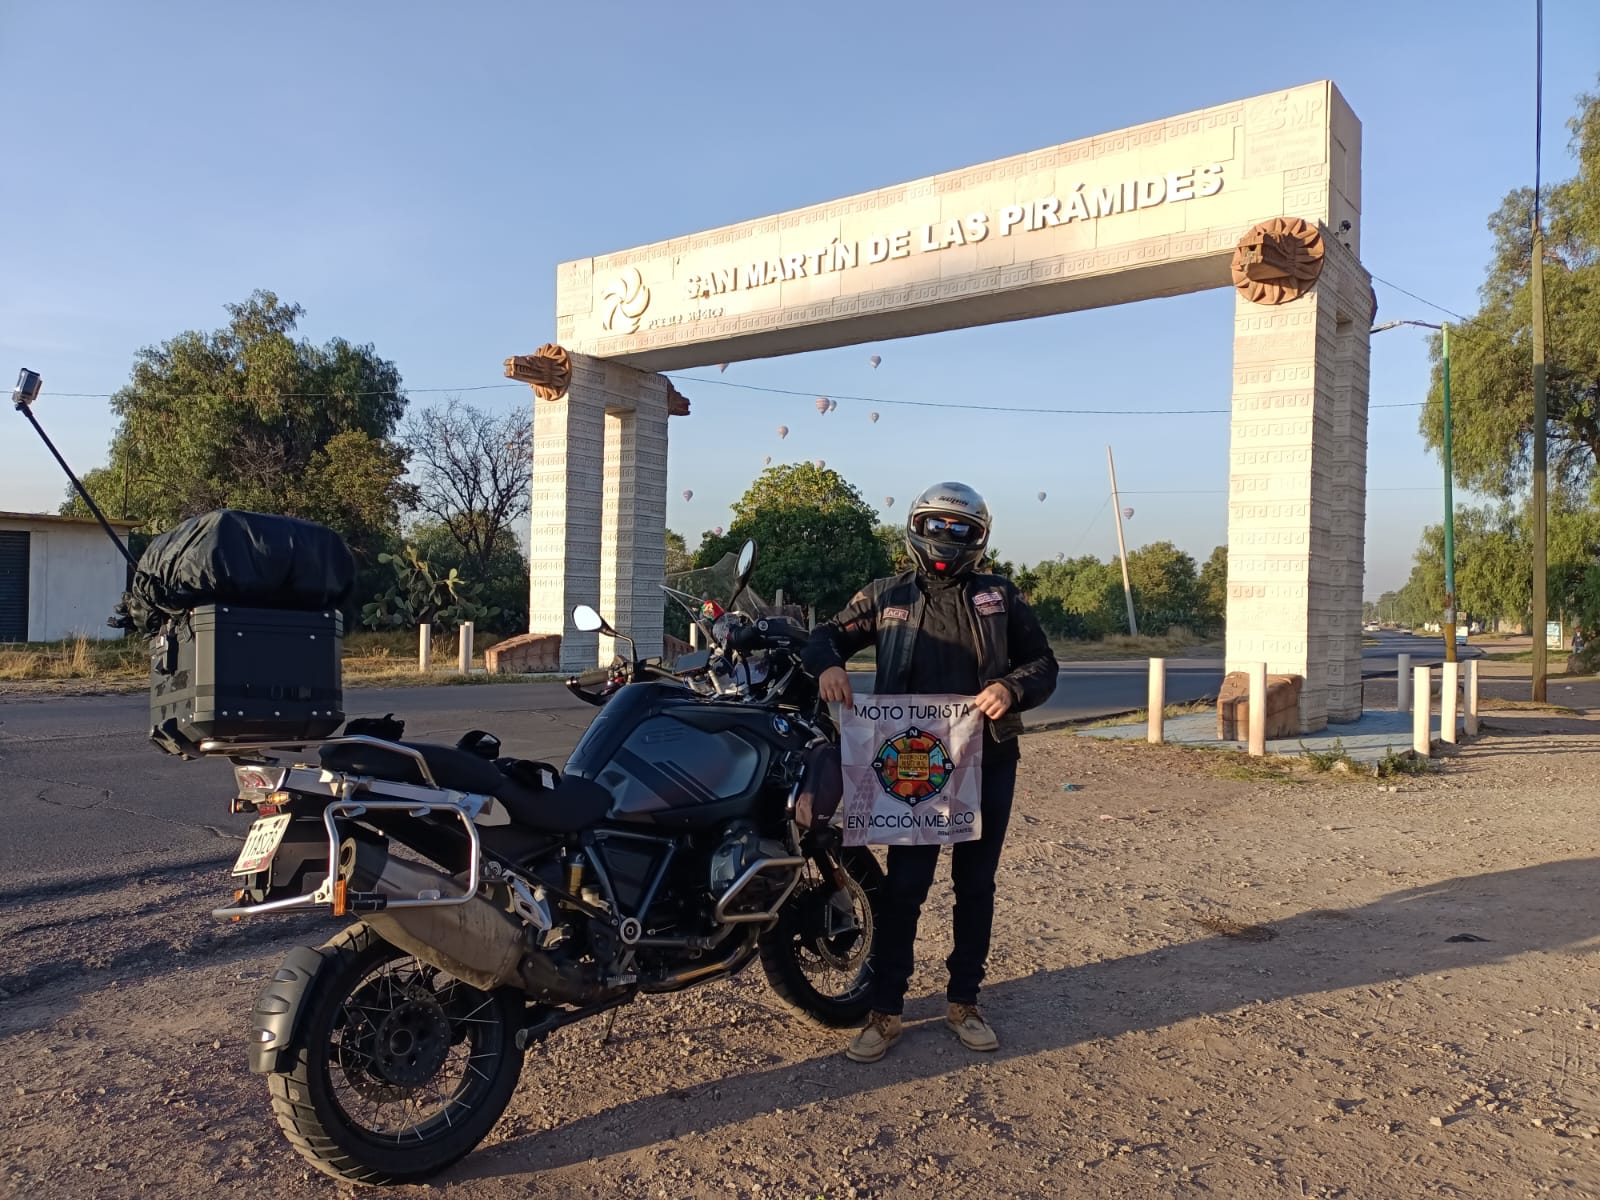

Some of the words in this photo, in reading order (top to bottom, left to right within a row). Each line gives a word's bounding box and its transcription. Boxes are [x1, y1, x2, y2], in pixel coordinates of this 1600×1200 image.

[687, 267, 737, 299] SAN
[745, 238, 859, 290] MARTÍN
[867, 230, 911, 264] DE
[920, 212, 989, 252] LAS
[999, 165, 1225, 237] PIRÁMIDES
[854, 704, 903, 720] MOTO
[908, 703, 970, 719] TURISTA
[847, 815, 865, 828] EN
[868, 812, 921, 828] ACCIÓN
[924, 811, 975, 828] MÉXICO
